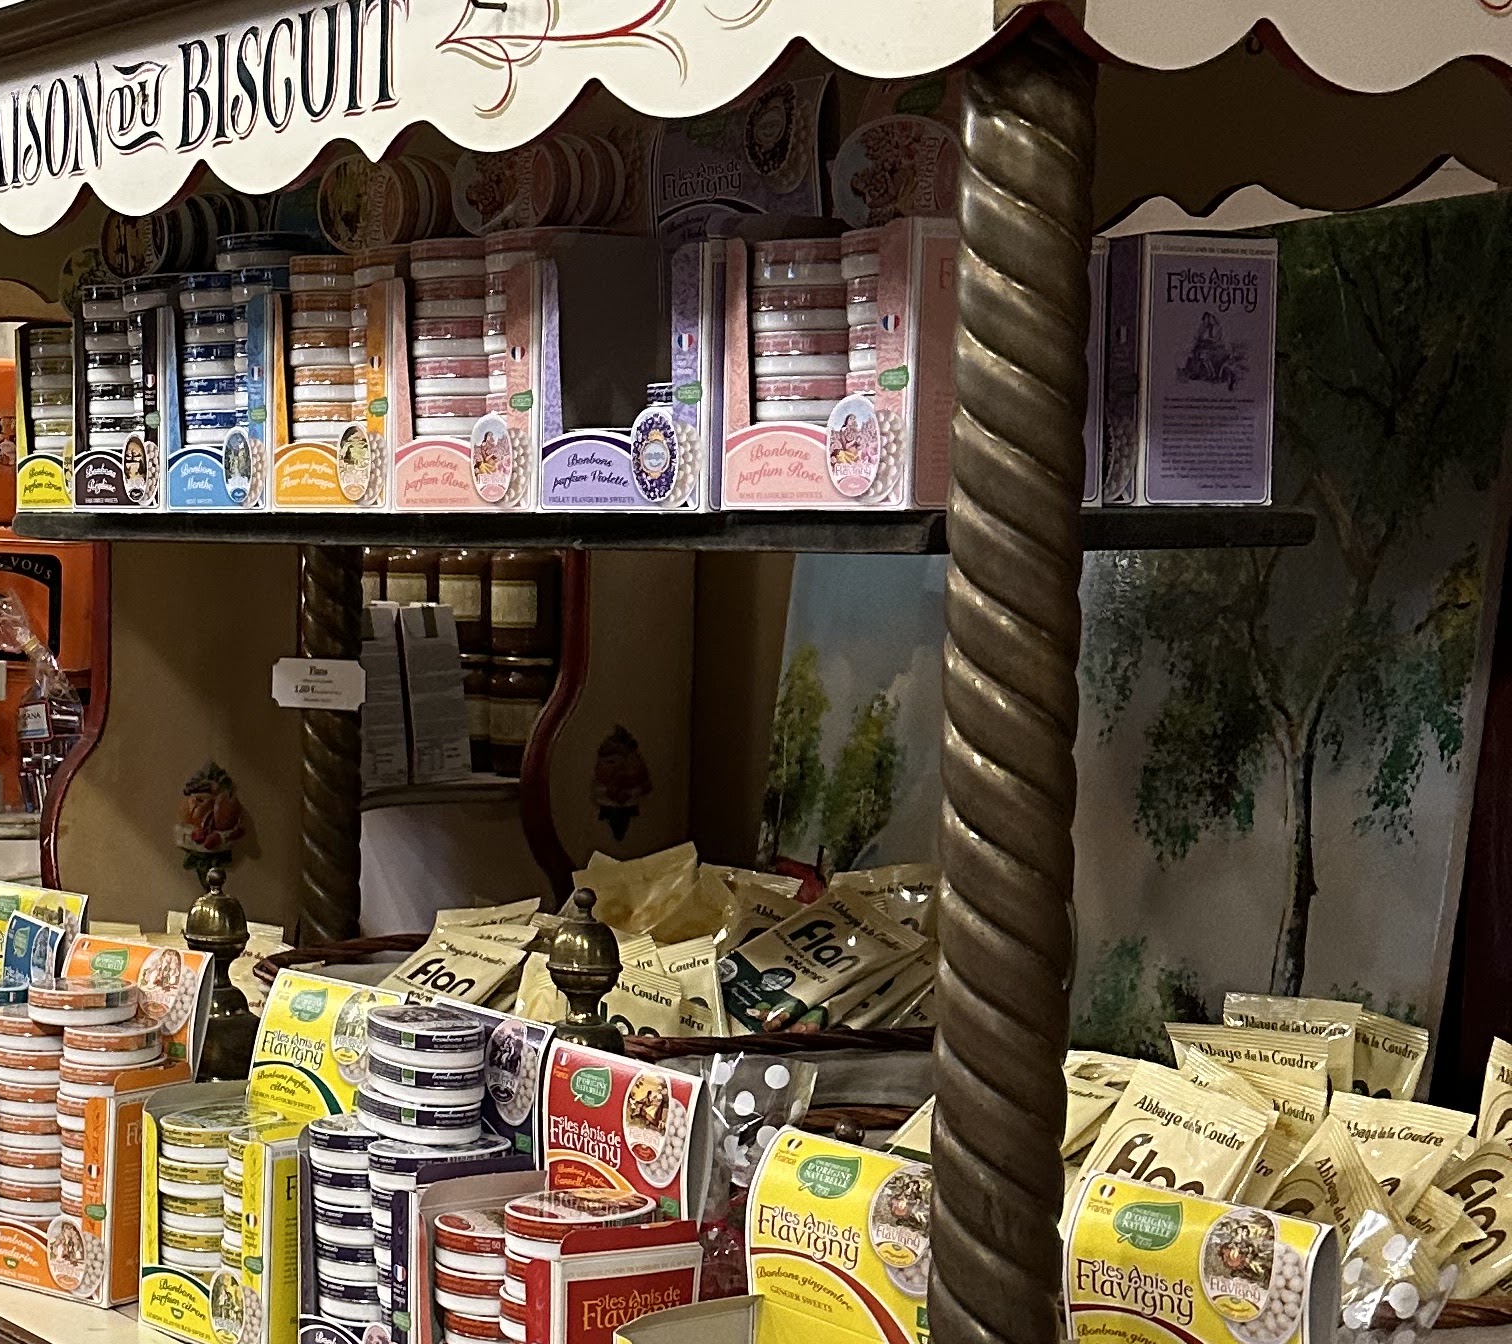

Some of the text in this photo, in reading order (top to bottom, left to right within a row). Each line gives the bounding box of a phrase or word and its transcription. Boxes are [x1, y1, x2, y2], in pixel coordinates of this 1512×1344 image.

[111, 71, 165, 144] DU
[662, 171, 742, 201] Flavigny
[1188, 268, 1258, 287] les Anis de
[1167, 271, 1258, 312] Flavigny
[567, 452, 613, 468] Bonbons
[750, 441, 811, 462] Bonbons
[441, 474, 470, 491] Rose
[590, 468, 630, 488] Violette
[738, 463, 824, 493] parfum Rose
[788, 919, 861, 974] Flan
[406, 958, 477, 997] Flan
[669, 958, 710, 974] Coudre
[631, 977, 673, 1007] Coudre
[262, 1030, 324, 1070] Flavigny
[275, 1031, 326, 1050] les Anis de
[1381, 1036, 1420, 1061] Coudre
[1244, 1049, 1257, 1061] de
[1271, 1049, 1318, 1071] Coudre
[270, 1082, 297, 1097] citron
[1133, 1094, 1182, 1127] Abbaye
[1202, 1122, 1245, 1151] Coudre
[1281, 1100, 1316, 1123] Coudre
[550, 1114, 621, 1170] Flavigny
[565, 1119, 621, 1146] les Anis de
[1346, 1121, 1376, 1141] bbaye
[1397, 1126, 1445, 1147] Coudre
[803, 1169, 849, 1189] NATURELLE
[807, 1162, 853, 1181] D'ORIGINE
[1315, 1156, 1340, 1208] Abbaye
[1086, 1200, 1113, 1216] France
[1124, 1210, 1175, 1230] D'ORIGINE
[1441, 1168, 1506, 1266] Flan
[758, 1203, 860, 1271] Flavigny
[780, 1205, 861, 1244] les Anis de
[1121, 1219, 1172, 1239] NATURELLE
[159, 1278, 197, 1304] Bonbons
[756, 1265, 855, 1313] Bonbons gingembre
[1076, 1258, 1194, 1326] Flavigny
[1101, 1259, 1194, 1299] les Anis de
[150, 1290, 207, 1322] parfum citron
[603, 1286, 681, 1309] les Anis de
[770, 1284, 833, 1314] GINGER SWEETS
[1077, 1322, 1127, 1340] Bonbons
